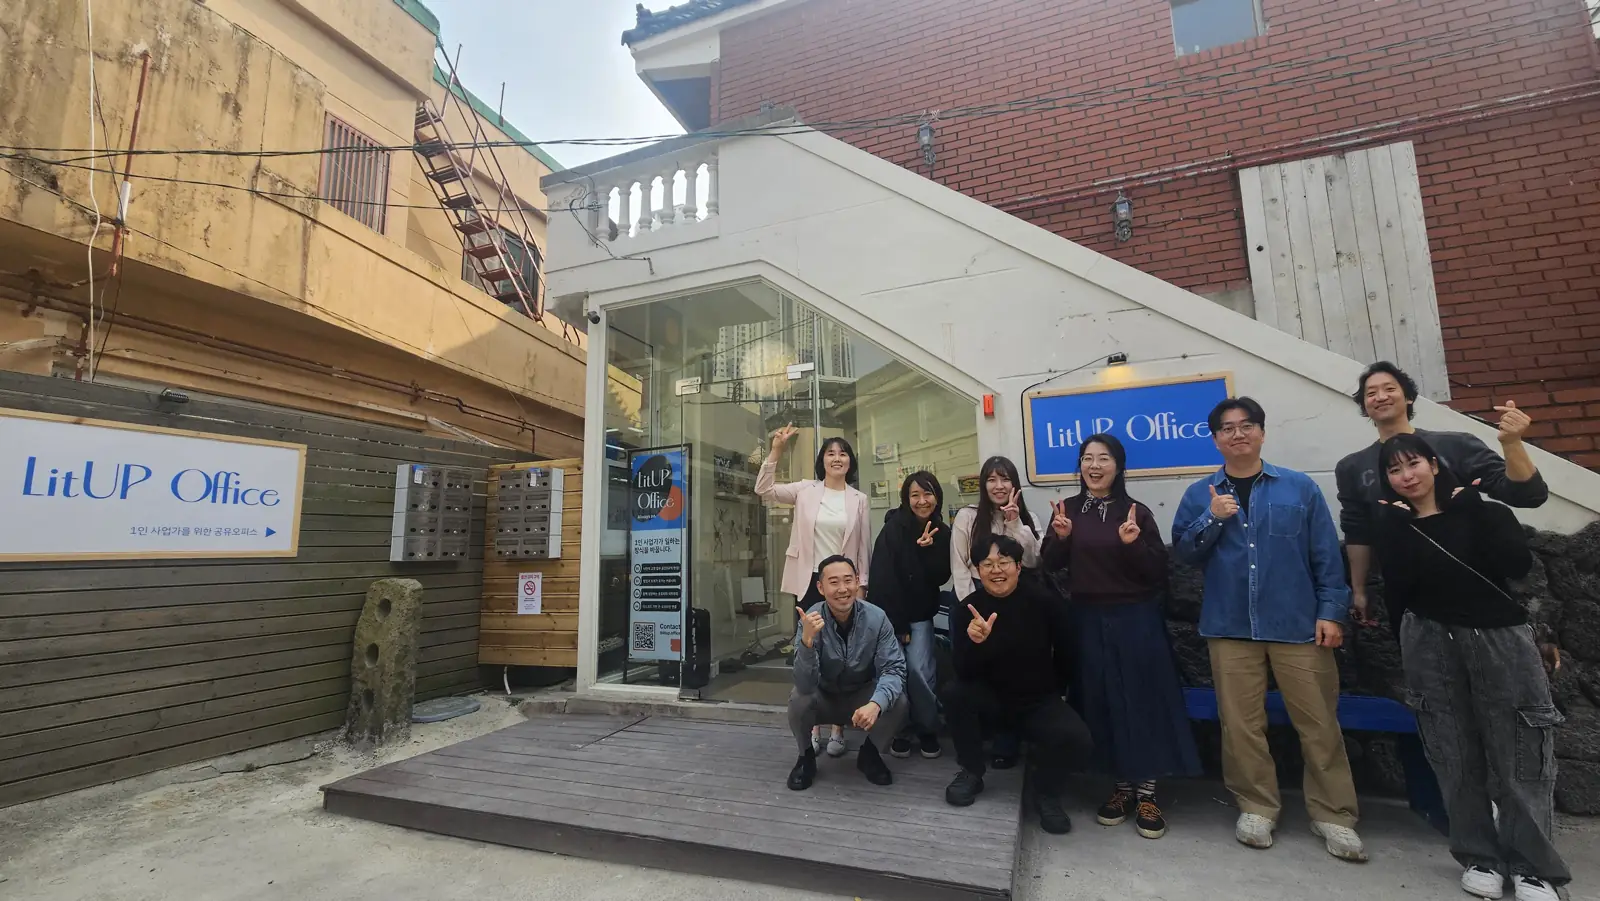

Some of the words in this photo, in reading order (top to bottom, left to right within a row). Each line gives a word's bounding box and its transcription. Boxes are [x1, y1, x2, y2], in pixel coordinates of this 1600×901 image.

[1126, 412, 1212, 441] Office
[22, 456, 152, 500] LitUP
[170, 468, 281, 507] Office
[638, 469, 670, 488] LitUP
[638, 492, 675, 509] Office
[129, 526, 148, 536] 1인
[150, 526, 191, 537] 사업가를
[193, 527, 213, 537] 위한
[214, 527, 258, 537] 공유오피스
